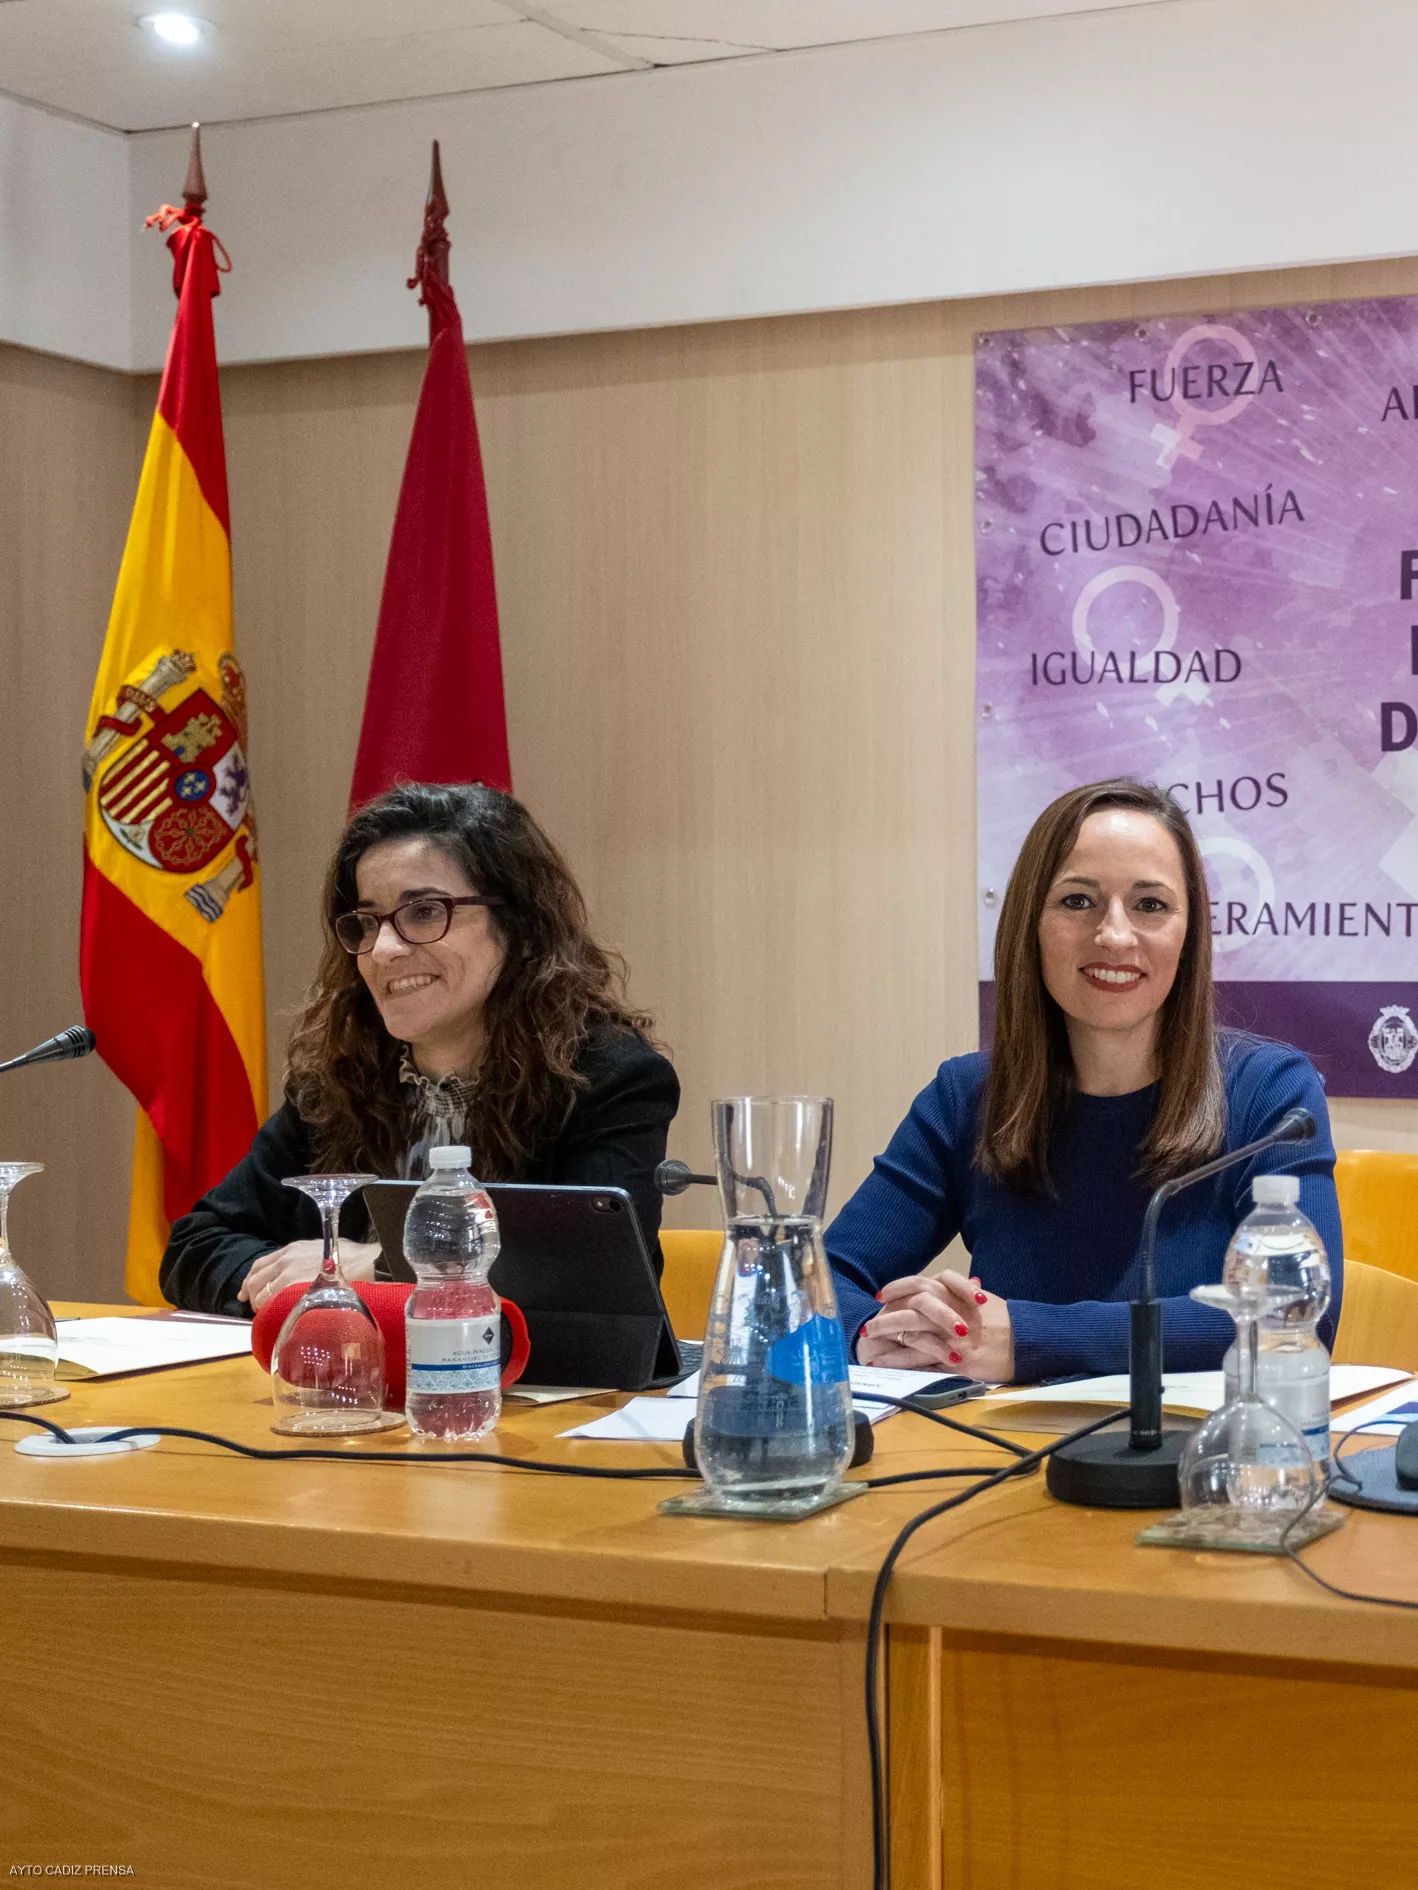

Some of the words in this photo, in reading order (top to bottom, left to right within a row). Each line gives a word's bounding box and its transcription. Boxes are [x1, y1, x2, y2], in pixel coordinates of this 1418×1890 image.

[1128, 359, 1284, 404] FUERZA
[1039, 483, 1305, 556] CIUDADANÍA
[1031, 648, 1242, 687] IGUALDAD
